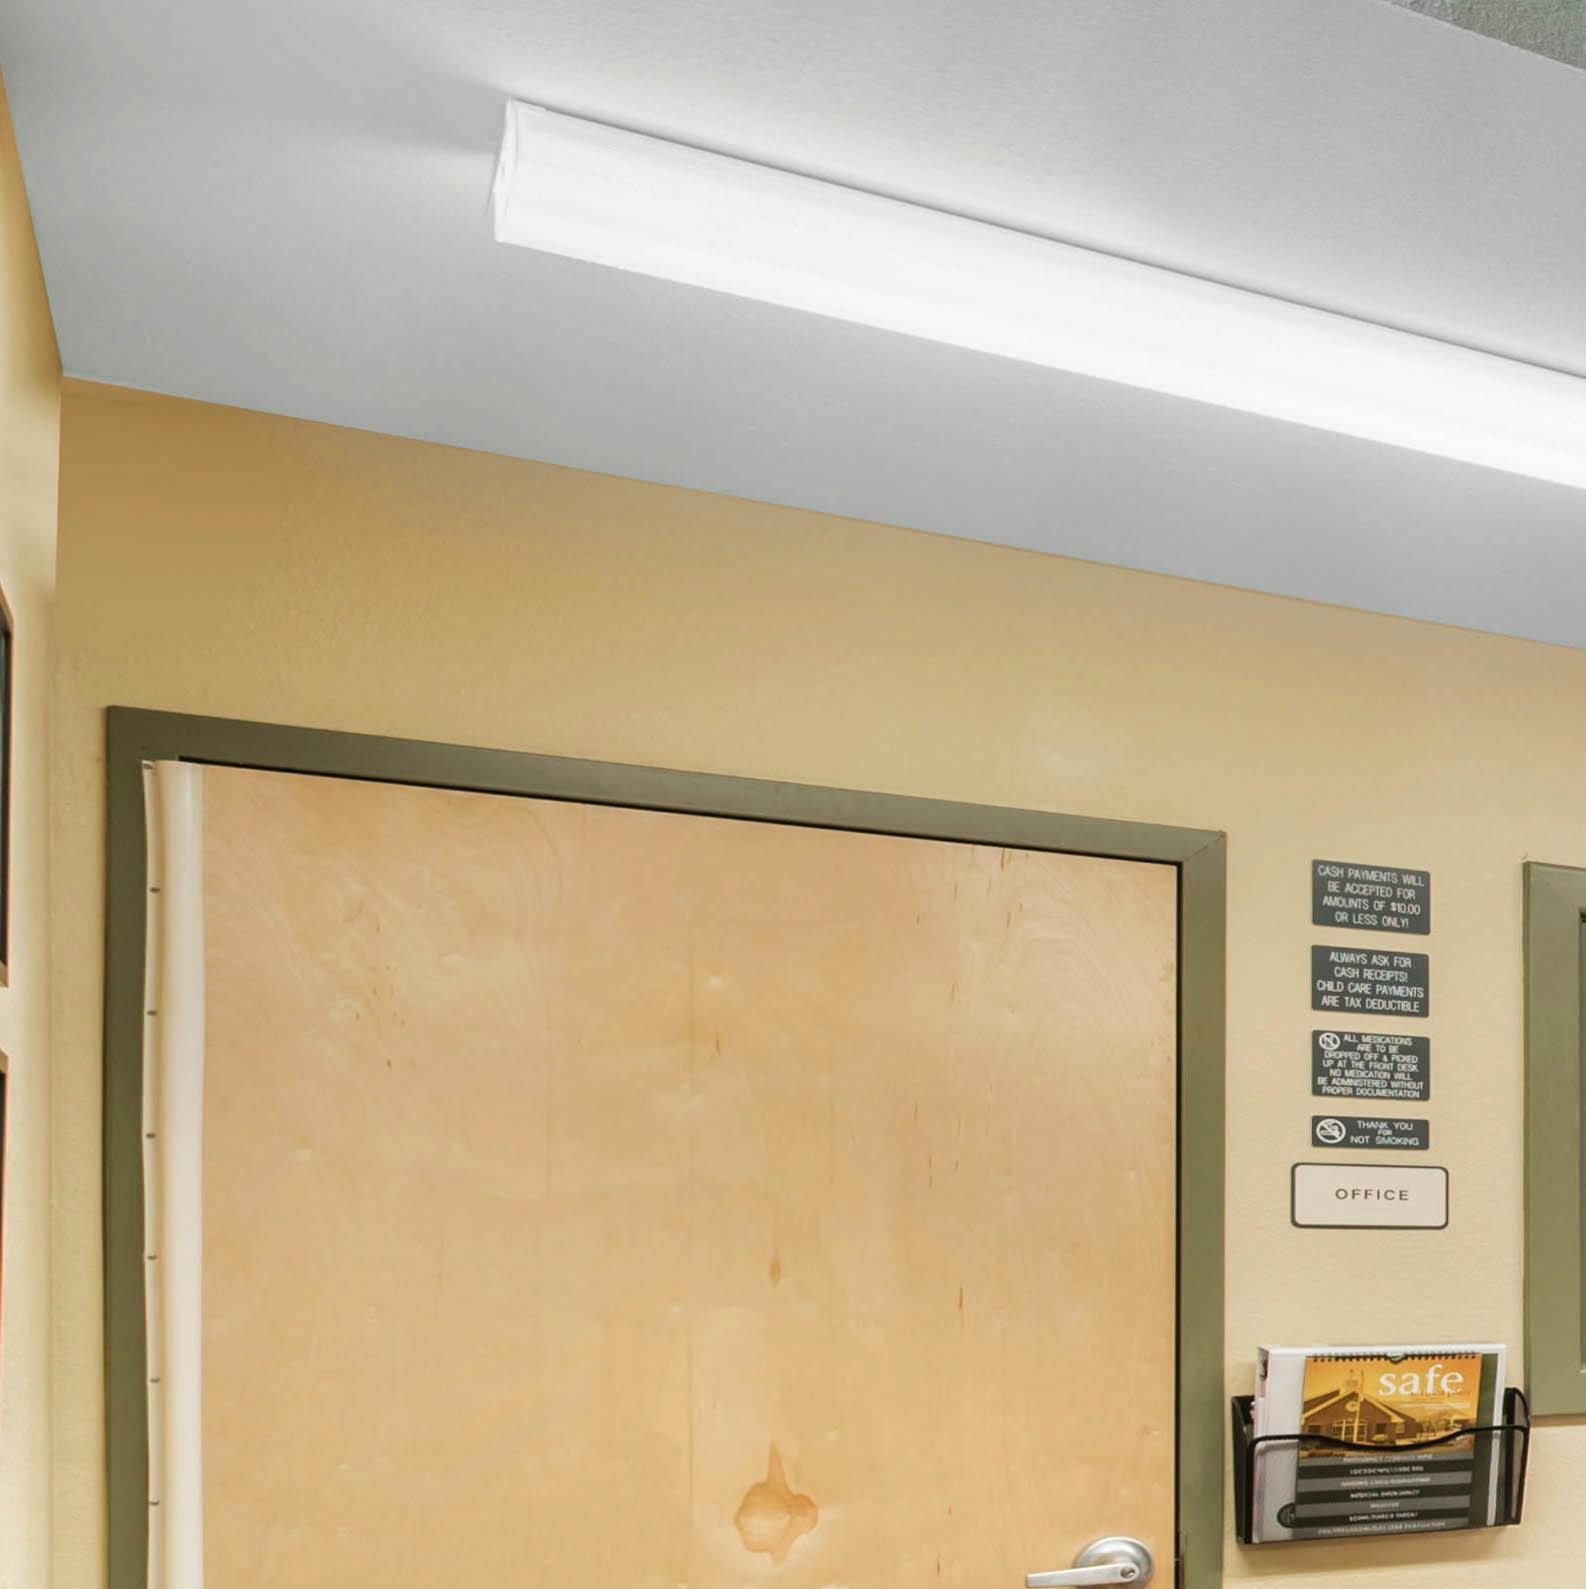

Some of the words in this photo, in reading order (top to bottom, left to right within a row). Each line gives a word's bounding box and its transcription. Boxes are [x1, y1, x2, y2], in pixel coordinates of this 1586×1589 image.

[1317, 864, 1344, 878] CASH
[1347, 868, 1399, 884] PAYMENTS
[1401, 873, 1425, 887] WILL
[1327, 880, 1340, 893] BE
[1344, 882, 1393, 898] ACCEPTED
[1396, 888, 1416, 899] FOR
[1322, 895, 1369, 910] AMOUNTS
[1373, 900, 1387, 911] OF
[1390, 902, 1421, 915] $10.00
[1334, 911, 1349, 923] OR
[1352, 913, 1378, 926] LESS
[1381, 916, 1409, 928] ONLY!
[1329, 951, 1368, 965] ALWAYS
[1371, 954, 1390, 966] ASK
[1393, 956, 1412, 968] FOR
[1334, 966, 1360, 978] CASH
[1363, 968, 1408, 983] RECEIPTS!
[1316, 979, 1345, 992] CHILD
[1347, 982, 1372, 994] CARE
[1375, 984, 1424, 998] PAYMENTS
[1321, 995, 1340, 1007] ARE
[1344, 996, 1362, 1008] TAX
[1365, 998, 1420, 1012] DEDUCTIBLE
[1343, 1034, 1359, 1042] ALL
[1361, 1035, 1413, 1046] MEDICATIONS
[1356, 1044, 1372, 1052] ARE
[1376, 1045, 1386, 1053] TO
[1388, 1045, 1399, 1054] BE
[1323, 1050, 1361, 1060] DROPPED
[1363, 1052, 1380, 1061] OFF
[1391, 1054, 1418, 1063] PICKED
[1322, 1060, 1334, 1068] UP
[1336, 1060, 1348, 1068] AT
[1351, 1061, 1366, 1069] THE
[1369, 1062, 1394, 1070] FRONT
[1329, 1069, 1342, 1077] NO
[1344, 1069, 1391, 1079] MEDICATION
[1317, 1076, 1328, 1085] BE
[1331, 1078, 1387, 1088] ADMINISTERED
[1390, 1081, 1424, 1090] WITHOUT
[1322, 1086, 1353, 1095] PROPER
[1356, 1087, 1420, 1098] DOCUMENTATION
[1357, 1120, 1388, 1129] THANK
[1392, 1121, 1413, 1131] YOU
[1349, 1136, 1370, 1144] NOT
[1375, 1136, 1419, 1146] SMOKING
[1335, 1188, 1409, 1201] OFFICE
[1378, 1363, 1464, 1396] safe
